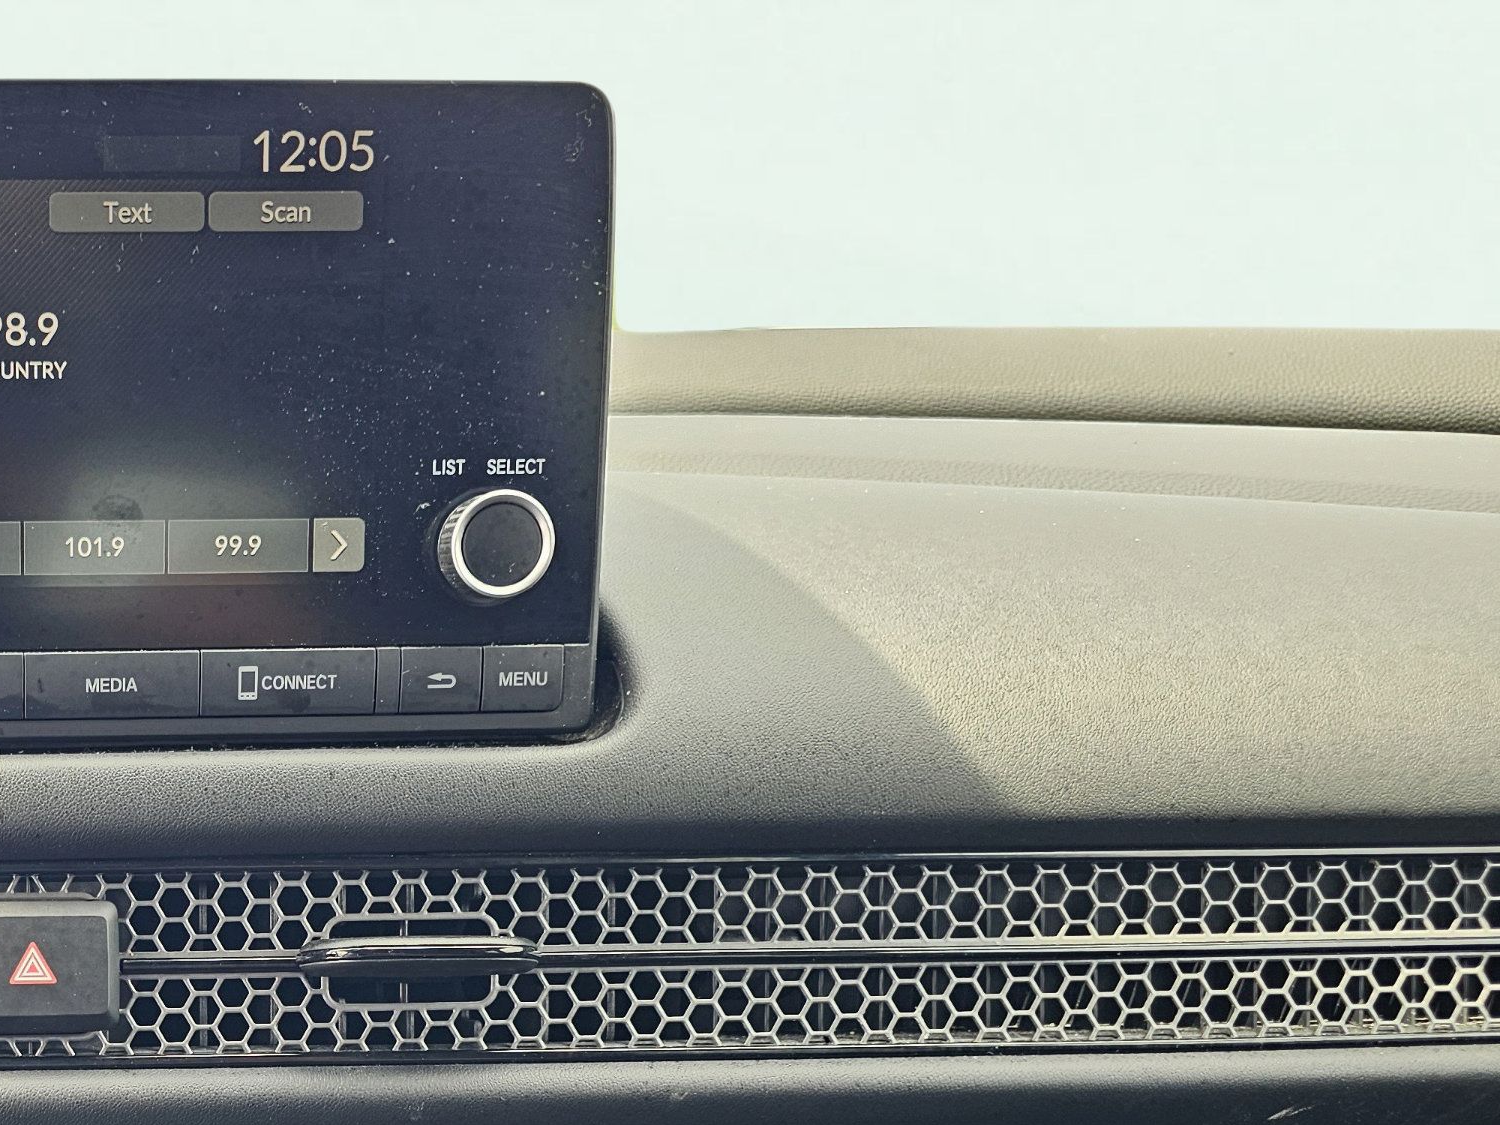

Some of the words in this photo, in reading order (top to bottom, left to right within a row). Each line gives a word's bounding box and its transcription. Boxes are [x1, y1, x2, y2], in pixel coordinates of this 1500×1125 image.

[254, 130, 374, 172] 12:05
[104, 201, 152, 223] Text
[261, 201, 310, 222] Scan
[433, 459, 465, 475] LIST
[487, 459, 545, 474] SELECT
[66, 537, 124, 557] 101.9
[215, 535, 261, 555] 99.9
[86, 678, 137, 692] MEDIA
[262, 674, 337, 690] CONNECT
[499, 672, 547, 686] MENU
